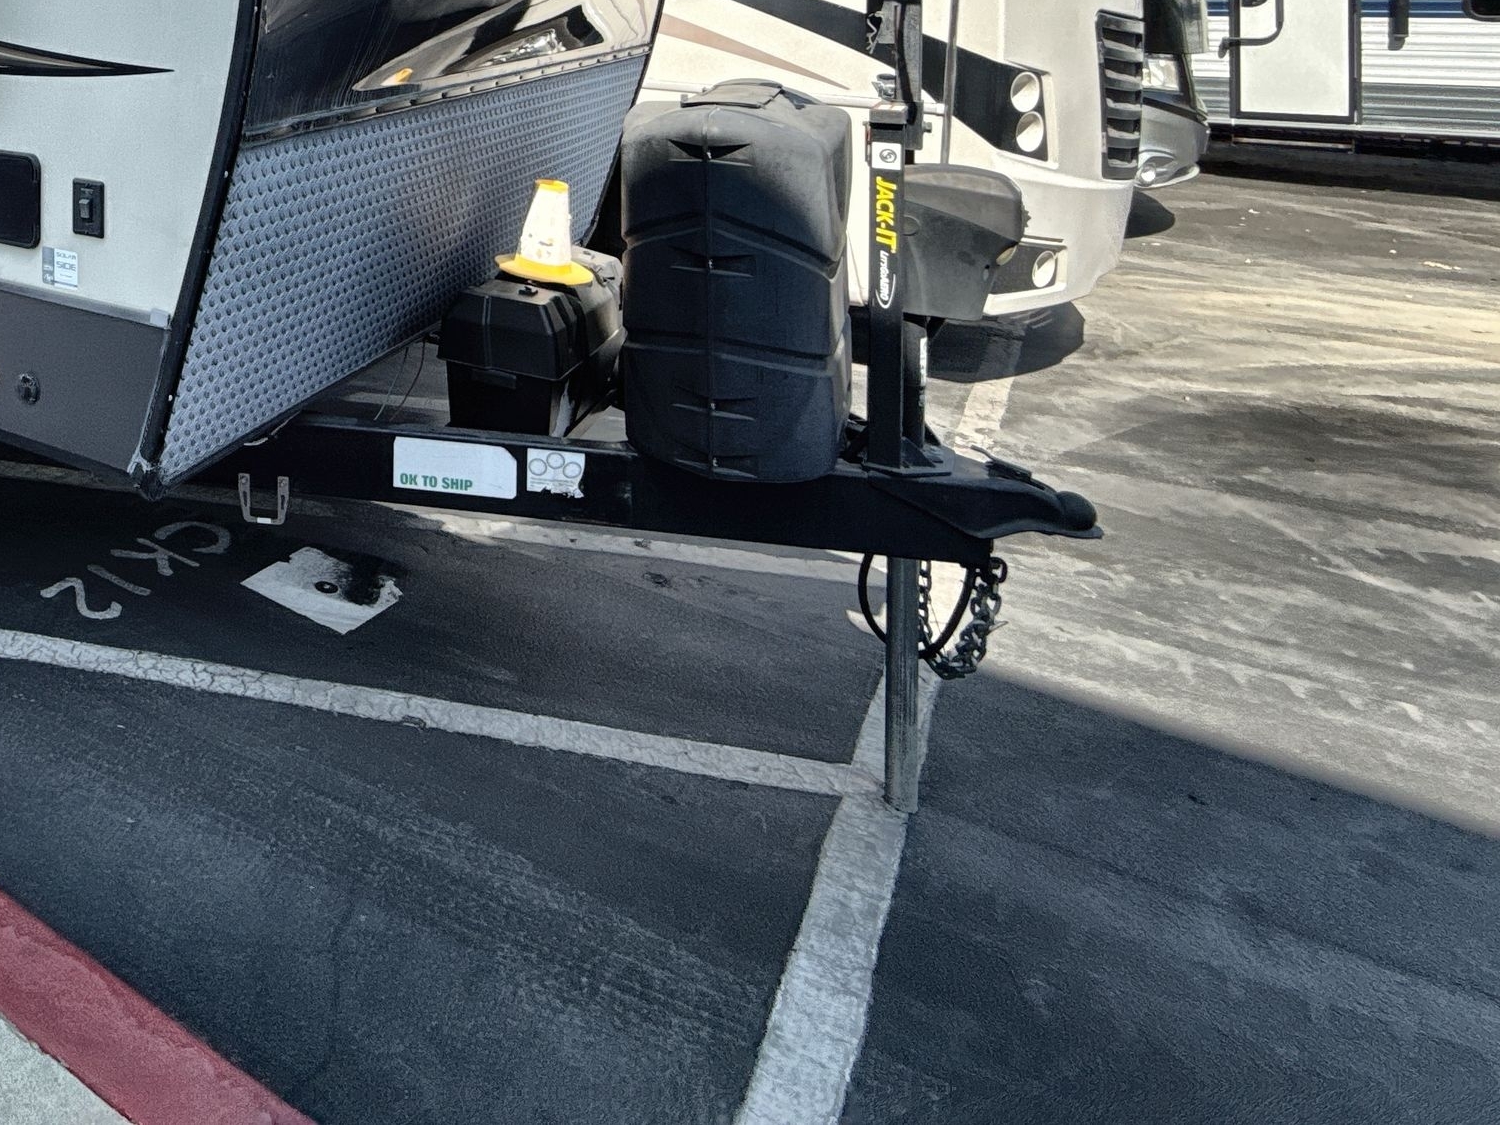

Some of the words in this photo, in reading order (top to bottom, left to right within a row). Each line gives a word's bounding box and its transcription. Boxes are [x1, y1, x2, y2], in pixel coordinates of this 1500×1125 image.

[876, 176, 897, 251] JACK-IT
[400, 473, 418, 486] OK
[421, 475, 438, 488] TO
[441, 477, 473, 491] SHIP
